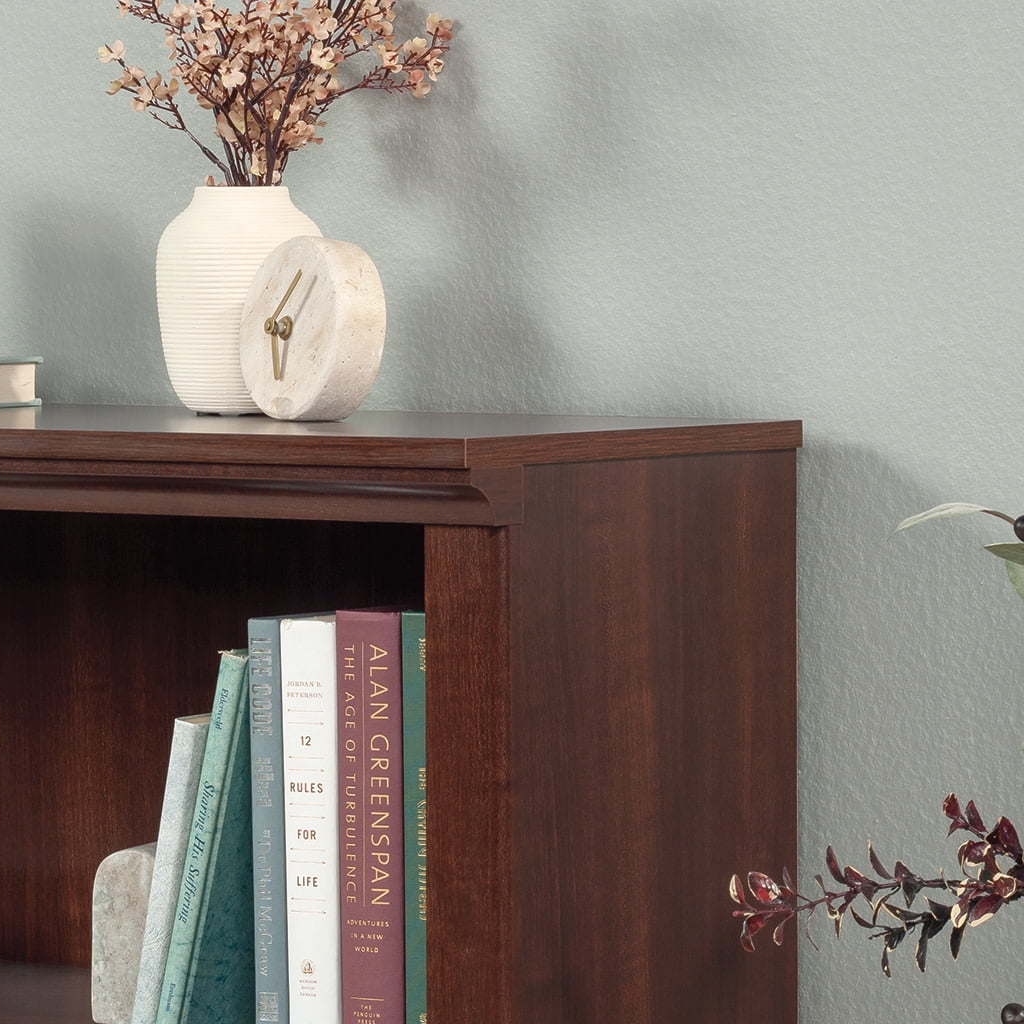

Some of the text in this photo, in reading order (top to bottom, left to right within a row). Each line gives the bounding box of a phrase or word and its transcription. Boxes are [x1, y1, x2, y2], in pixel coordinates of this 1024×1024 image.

[287, 680, 314, 688] JORDAN
[286, 691, 323, 699] PETERSON
[300, 735, 312, 747] 12
[344, 644, 357, 903] THE AGE OF TURBULENCE
[369, 644, 390, 905] ALAN GREENSPAN
[290, 782, 324, 794] RULES
[297, 829, 317, 840] FOR
[178, 780, 215, 924] Sharing His Suffering
[257, 865, 272, 901] Phil
[296, 876, 318, 888] LIFE
[346, 919, 390, 928] ADVENTURES
